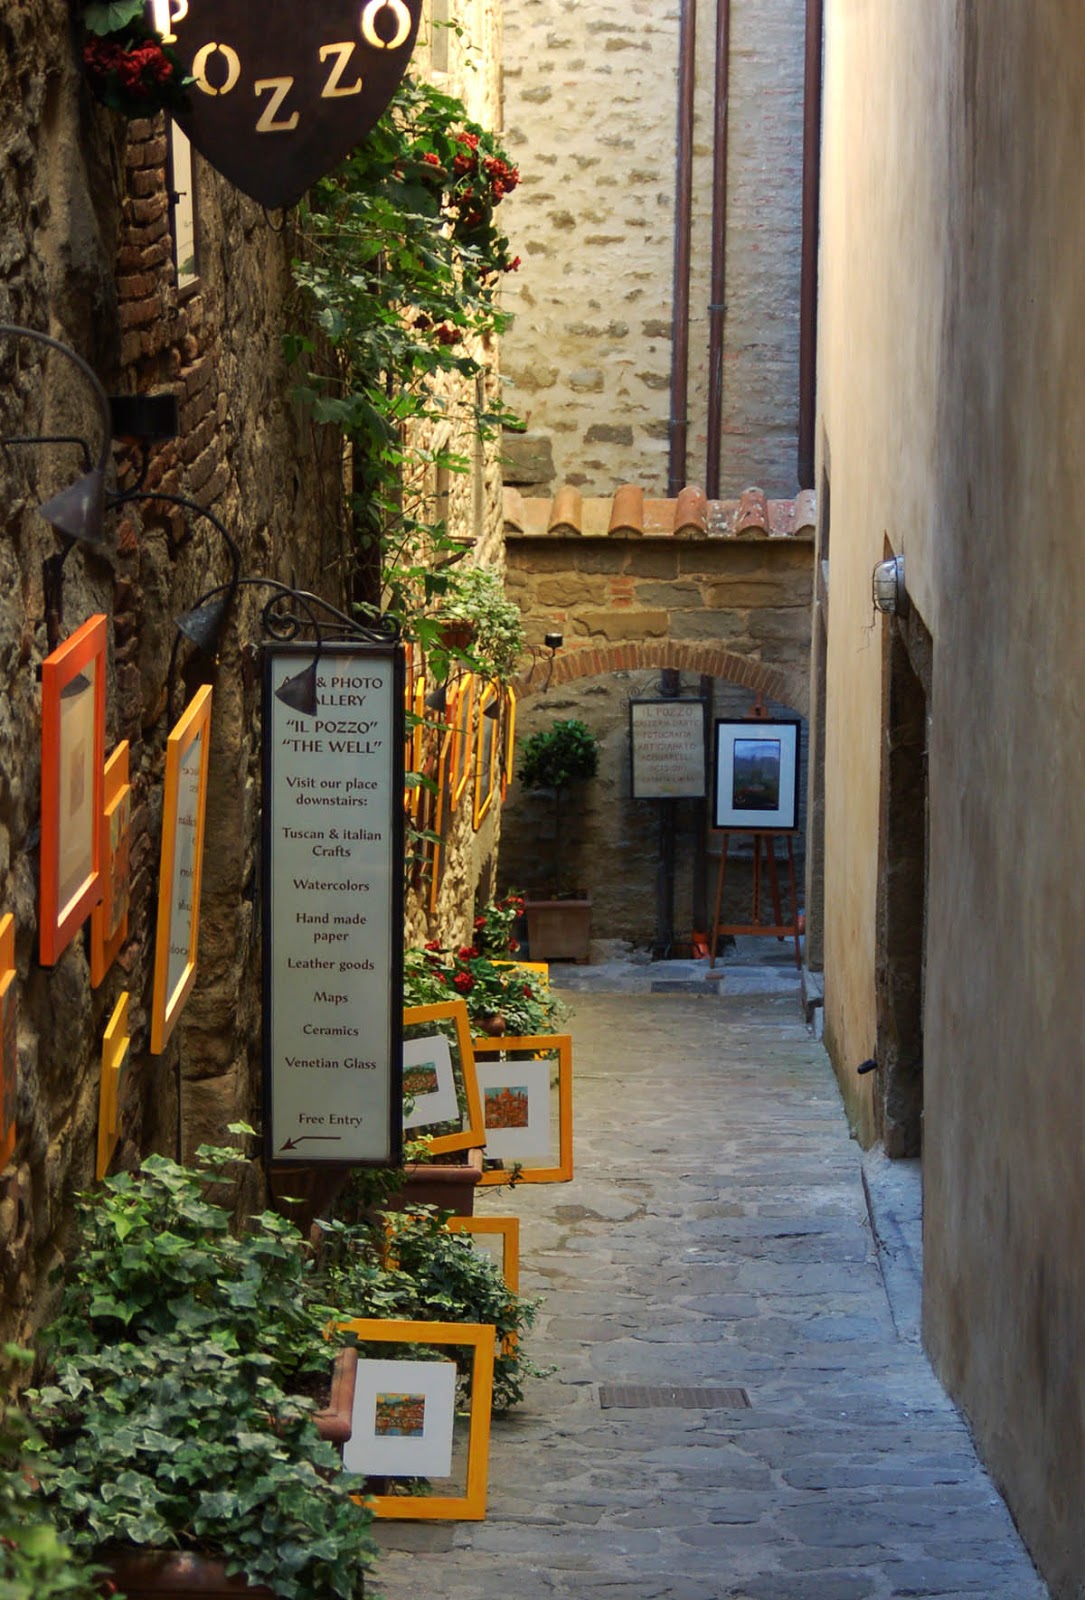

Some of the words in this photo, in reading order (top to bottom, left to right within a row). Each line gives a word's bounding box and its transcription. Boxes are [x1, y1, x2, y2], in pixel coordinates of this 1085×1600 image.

[153, 0, 412, 133] POZZO
[317, 677, 327, 688] &
[331, 677, 383, 689] PHOTO
[286, 777, 316, 788] Visit
[346, 777, 377, 792] place
[296, 793, 367, 806] downstairs:
[282, 827, 324, 839] Tuscan
[329, 828, 339, 839] &
[312, 845, 351, 857] Crafts
[293, 879, 369, 891] Watercolors
[296, 913, 329, 924] Hand
[334, 913, 367, 925] made
[313, 931, 349, 944] paper
[288, 958, 335, 969] Leather
[339, 959, 374, 972] goods
[314, 992, 348, 1005] Maps
[303, 1024, 359, 1036] Ceramics
[285, 1057, 339, 1068] Venetian
[344, 1058, 376, 1069] Glass
[299, 1113, 324, 1124] Free
[329, 1114, 362, 1128] Entry
